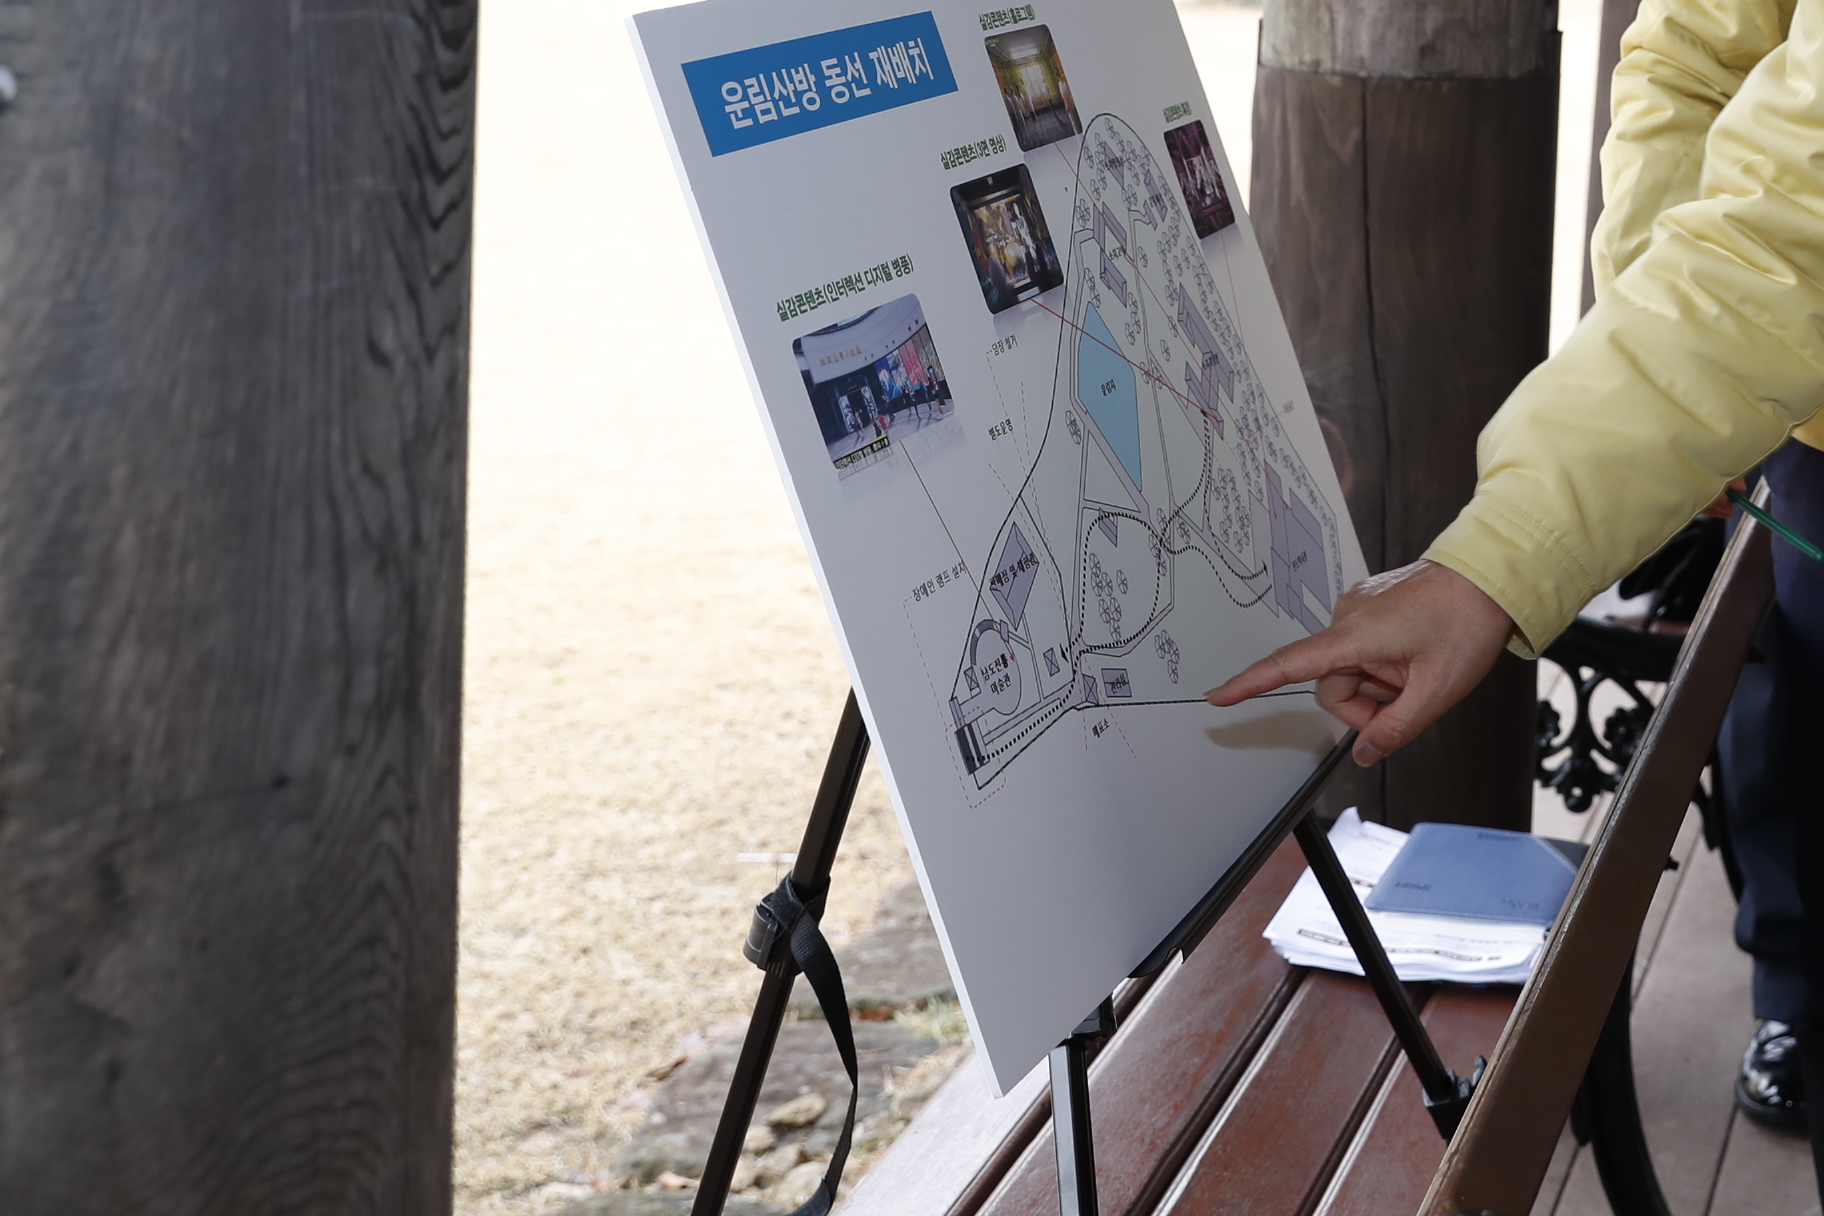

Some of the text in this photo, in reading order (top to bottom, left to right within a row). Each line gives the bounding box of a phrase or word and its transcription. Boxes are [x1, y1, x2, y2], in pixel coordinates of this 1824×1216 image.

[979, 4, 1035, 31] 실감콘텐츠(홀로그램)
[721, 37, 934, 130] 운림산방 동선 재배치
[989, 134, 1007, 155] 영상)
[863, 261, 894, 287] 디지털
[890, 253, 914, 278] 병풍)
[987, 418, 1014, 441] 별도운영
[912, 582, 936, 602] 장애인
[951, 561, 967, 580] 설치
[979, 653, 1009, 682] 남도전통
[990, 673, 1011, 695] 미술관
